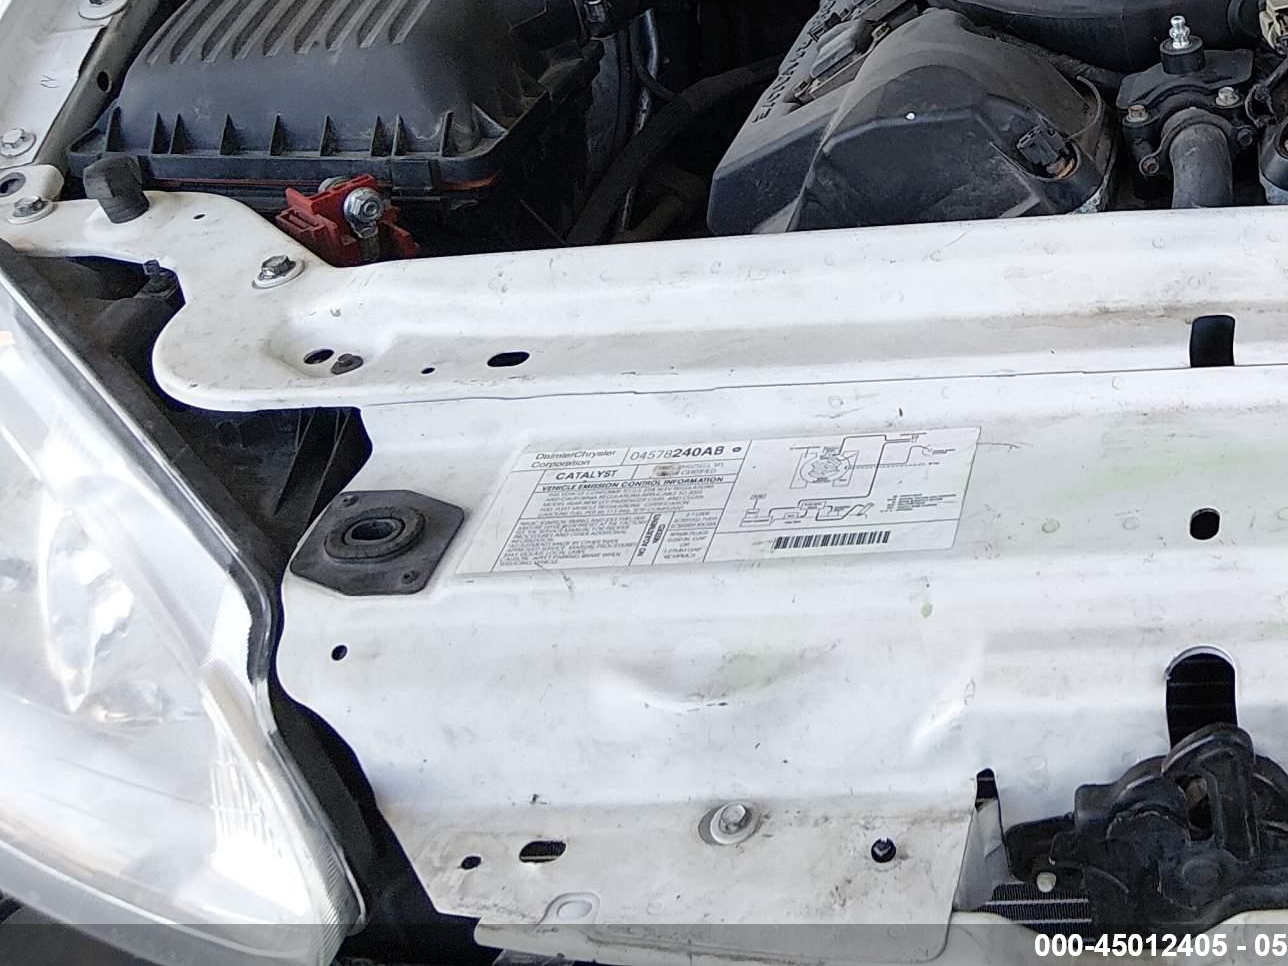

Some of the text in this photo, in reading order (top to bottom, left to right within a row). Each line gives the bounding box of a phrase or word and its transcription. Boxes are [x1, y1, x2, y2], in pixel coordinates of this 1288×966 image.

[630, 446, 725, 460] 04578240AB
[531, 459, 590, 468] Corporation
[555, 469, 618, 480] CATALYST
[542, 476, 724, 492] VEHICLE EMISSION CONTROL INFORMATION
